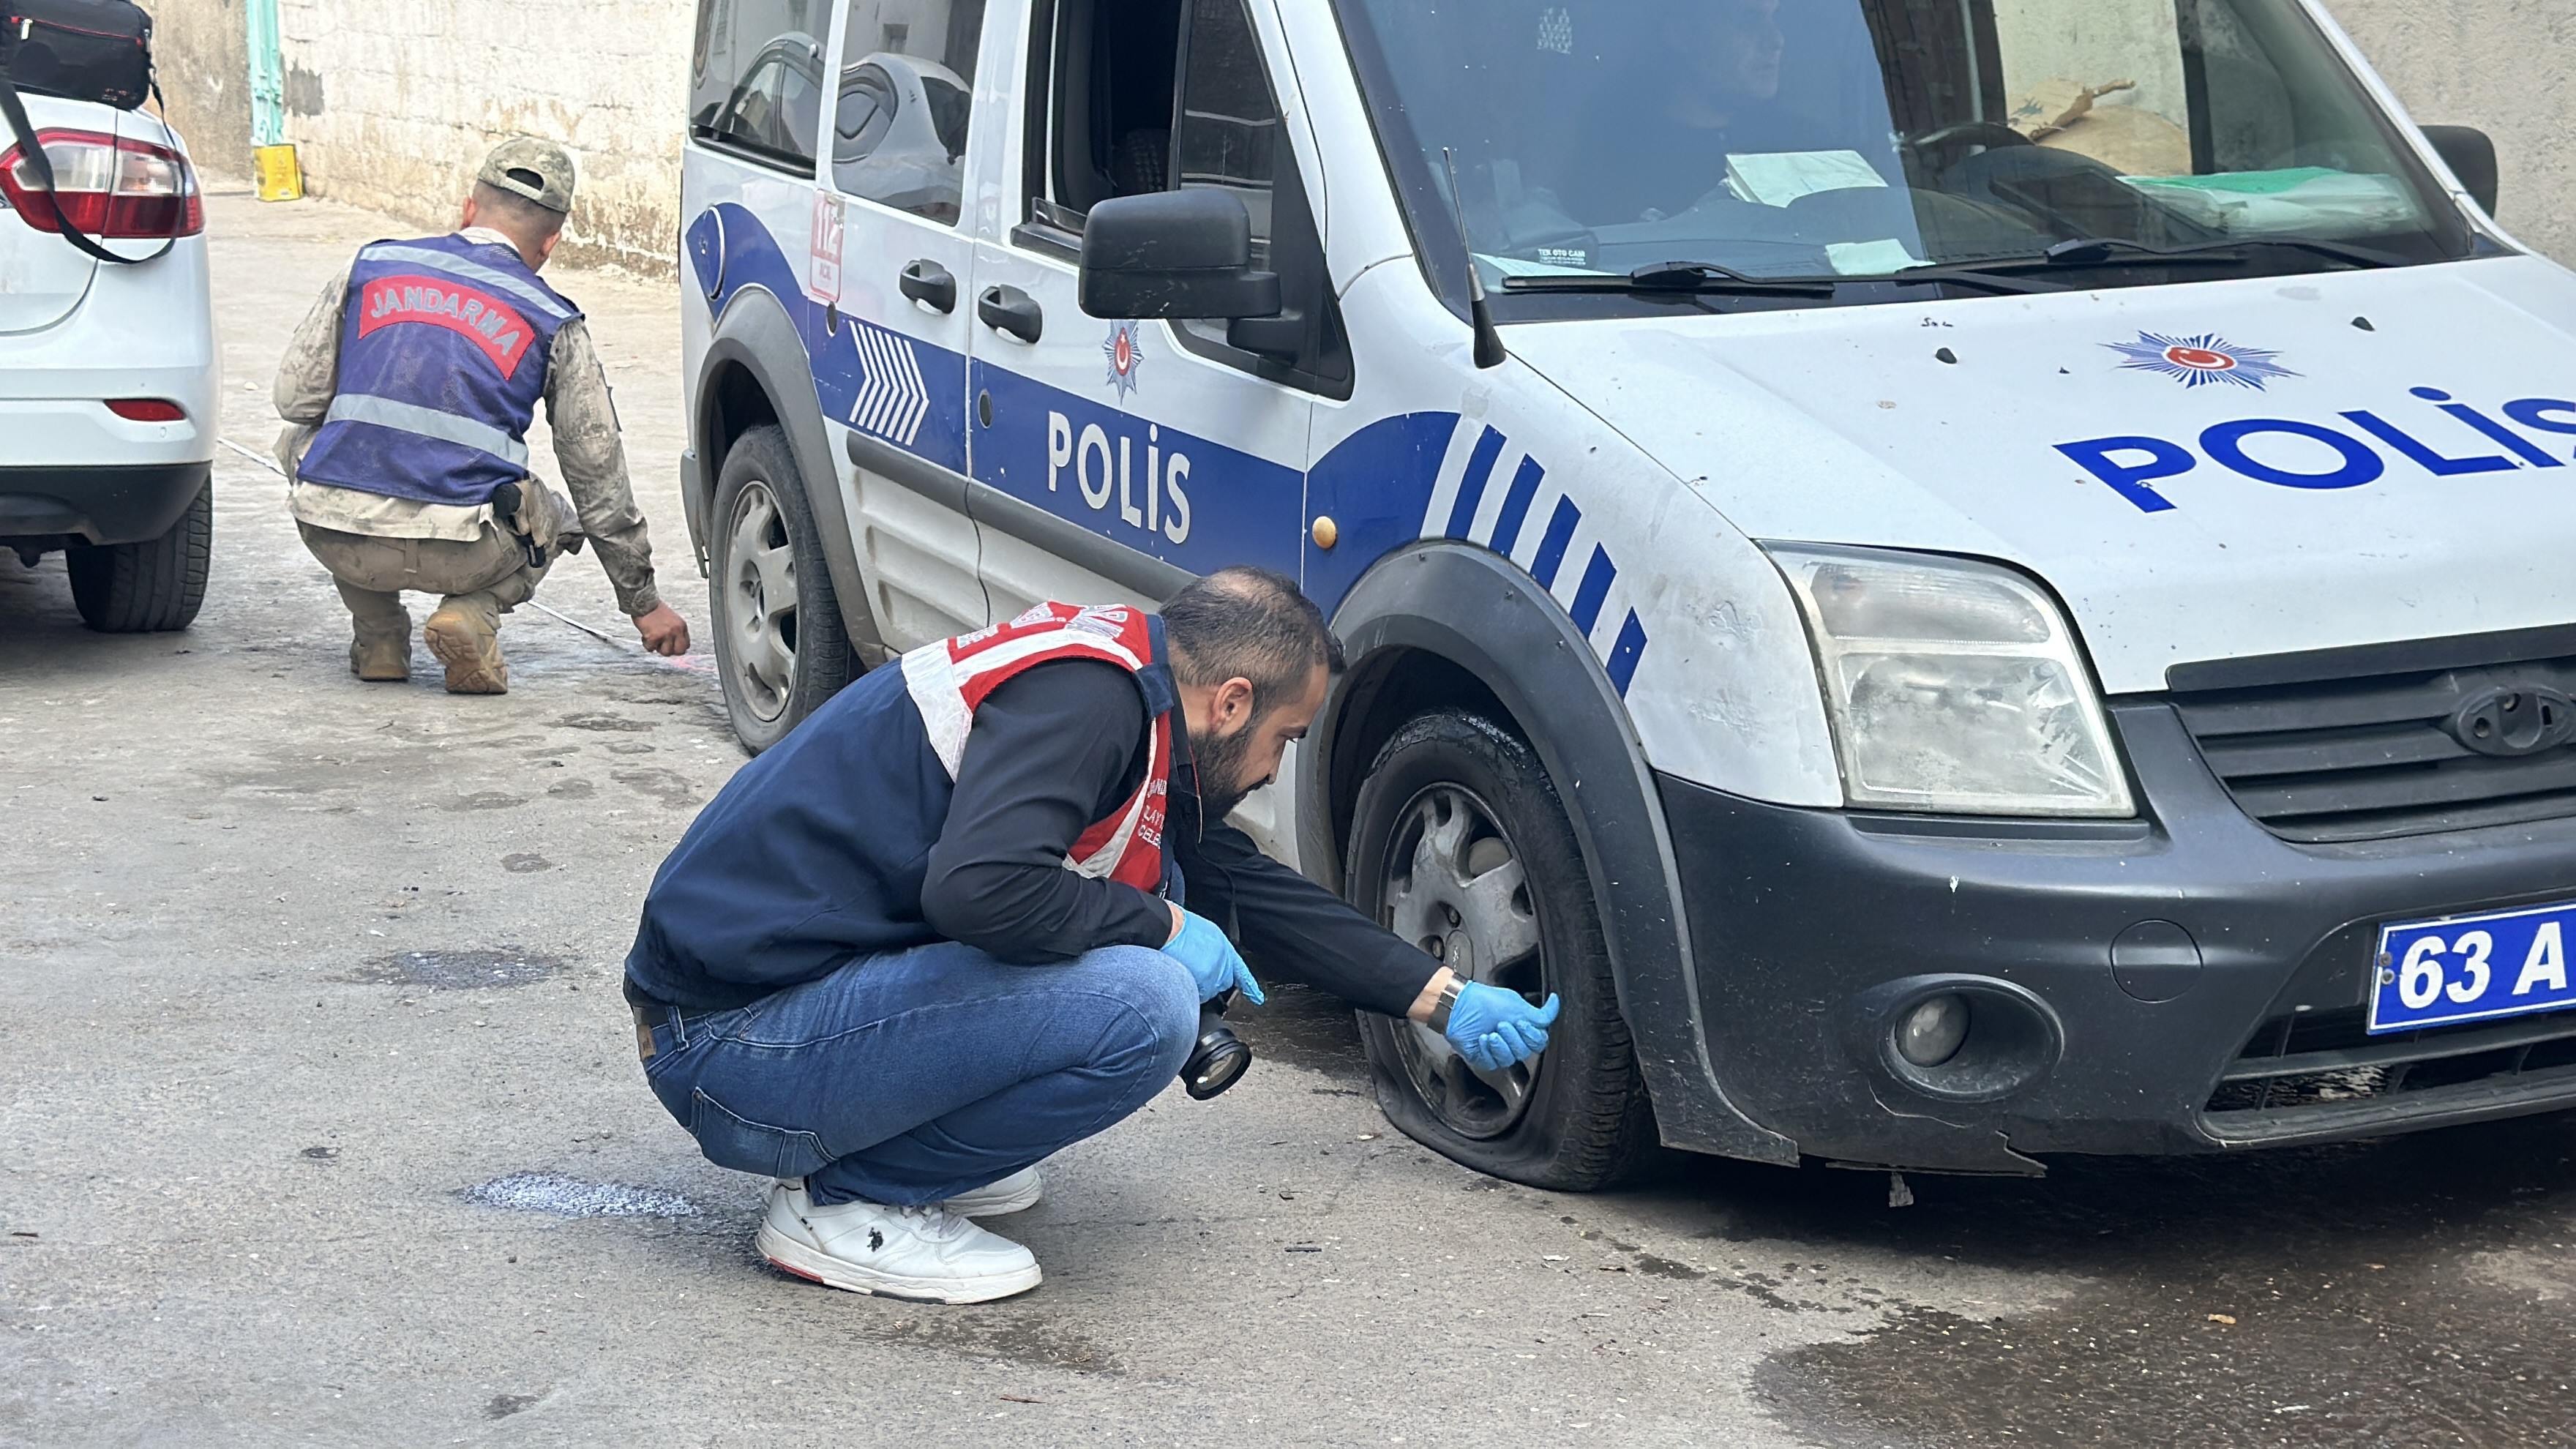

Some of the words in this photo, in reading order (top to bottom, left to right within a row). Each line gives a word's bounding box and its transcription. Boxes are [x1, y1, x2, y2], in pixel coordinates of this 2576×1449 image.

[372, 288, 519, 355] JANDARMA
[1049, 411, 1190, 544] POLİS
[2399, 930, 2493, 1008] 63
[2512, 921, 2566, 995] A
